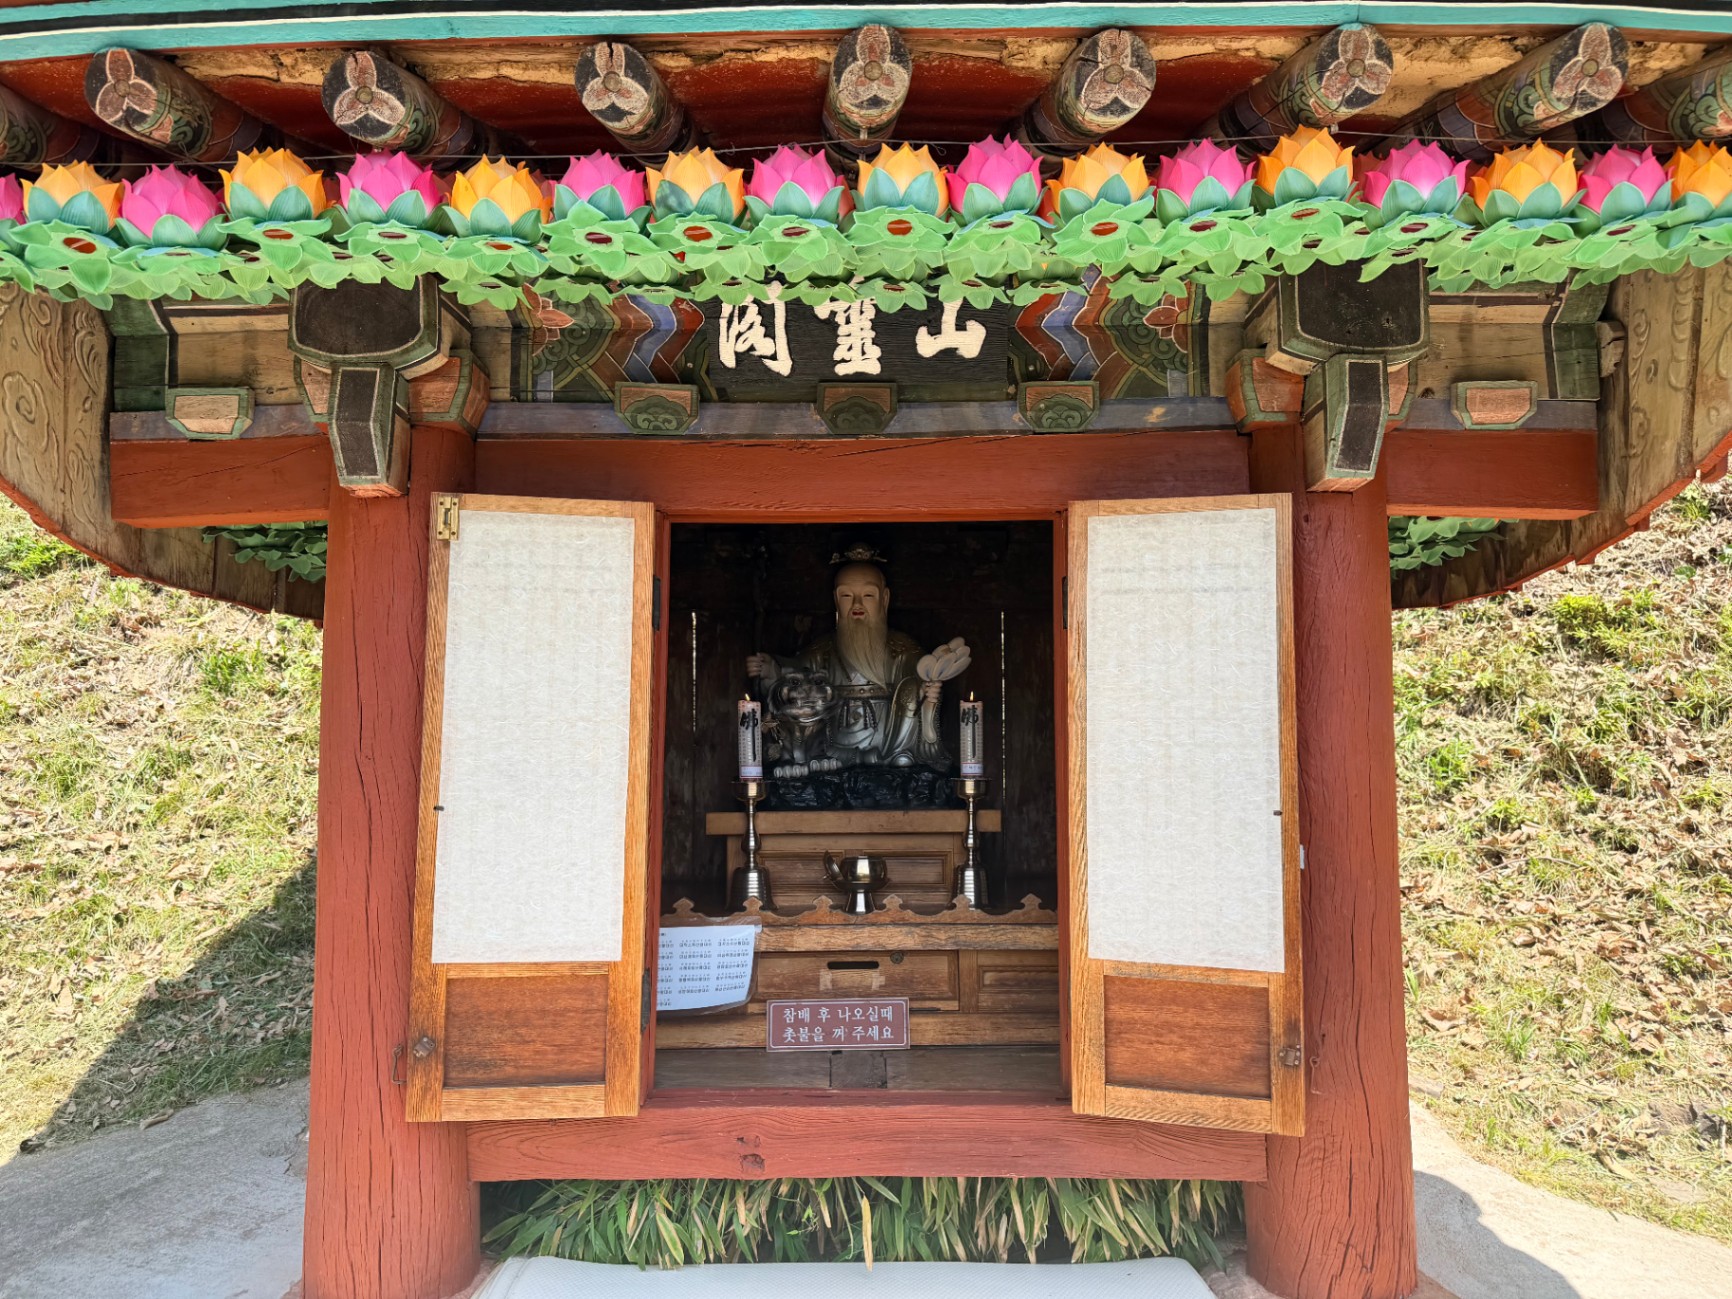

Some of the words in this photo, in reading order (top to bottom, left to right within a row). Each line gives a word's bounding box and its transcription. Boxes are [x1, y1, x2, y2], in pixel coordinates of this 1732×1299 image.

[783, 1007, 810, 1023] 참배
[817, 1007, 831, 1022] 후
[837, 1006, 893, 1022] 나오실때
[783, 1026, 825, 1043] 촛불을
[832, 1026, 845, 1041] 꺼
[852, 1025, 894, 1041] 주세요
